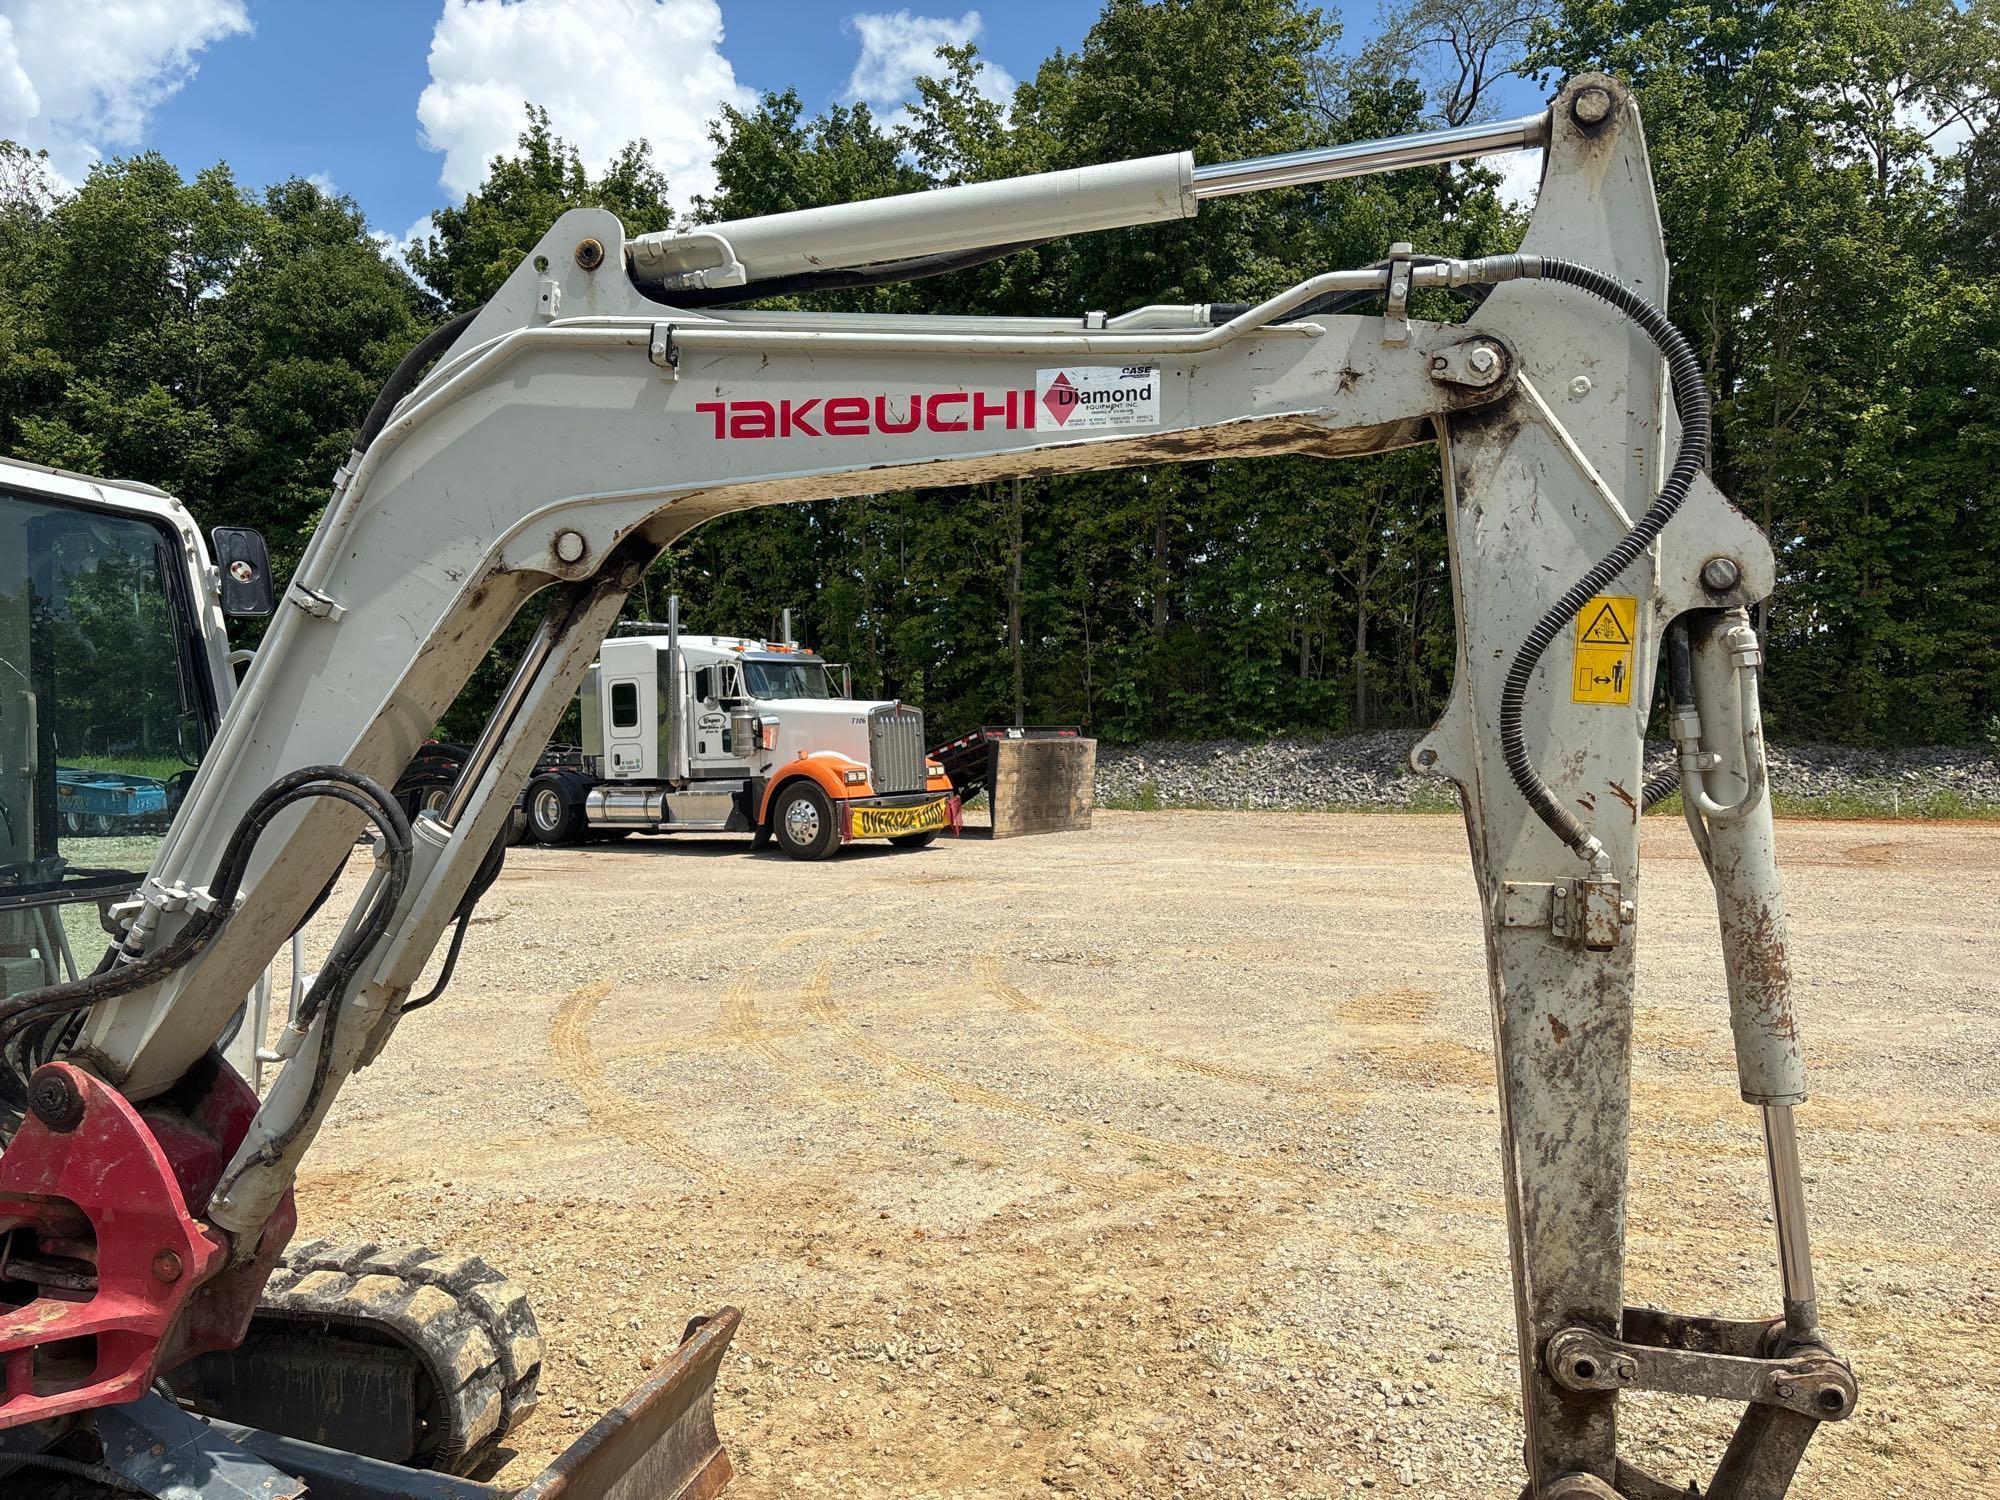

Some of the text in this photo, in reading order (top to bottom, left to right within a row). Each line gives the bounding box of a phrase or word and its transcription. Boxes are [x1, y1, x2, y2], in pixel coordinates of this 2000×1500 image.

[1121, 366, 1153, 375] CASE
[1059, 384, 1152, 406] Diamond
[1085, 403, 1123, 411] EQUIPMENT
[861, 809, 918, 834] OVERSIZE
